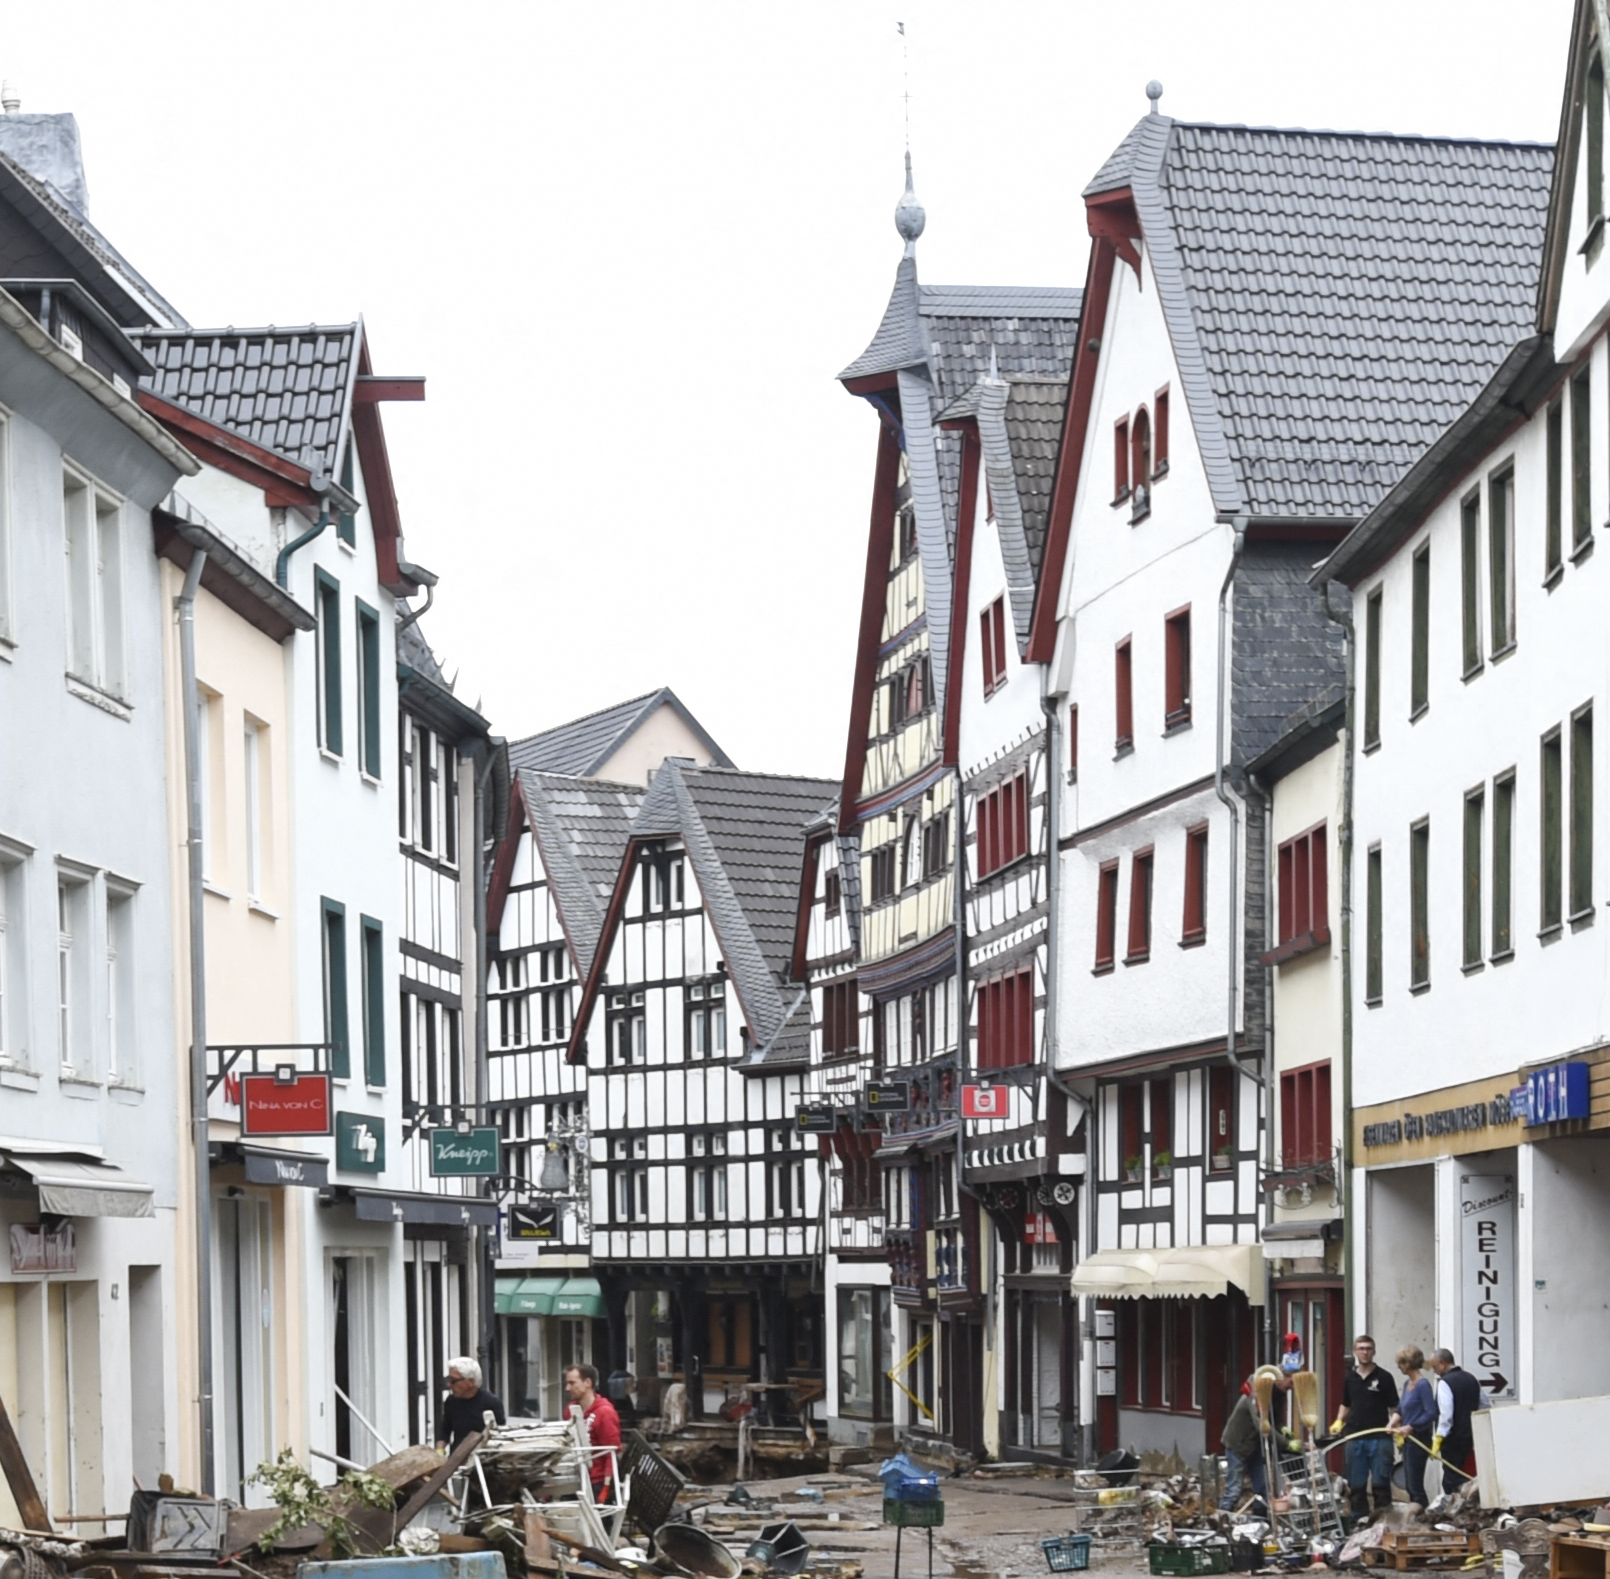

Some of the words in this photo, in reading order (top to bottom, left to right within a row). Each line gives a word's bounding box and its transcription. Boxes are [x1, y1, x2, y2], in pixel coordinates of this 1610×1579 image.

[1527, 1069, 1569, 1124] ROTH
[436, 1143, 489, 1166] Kneipp
[1477, 1220, 1501, 1368] REINIGUNG
